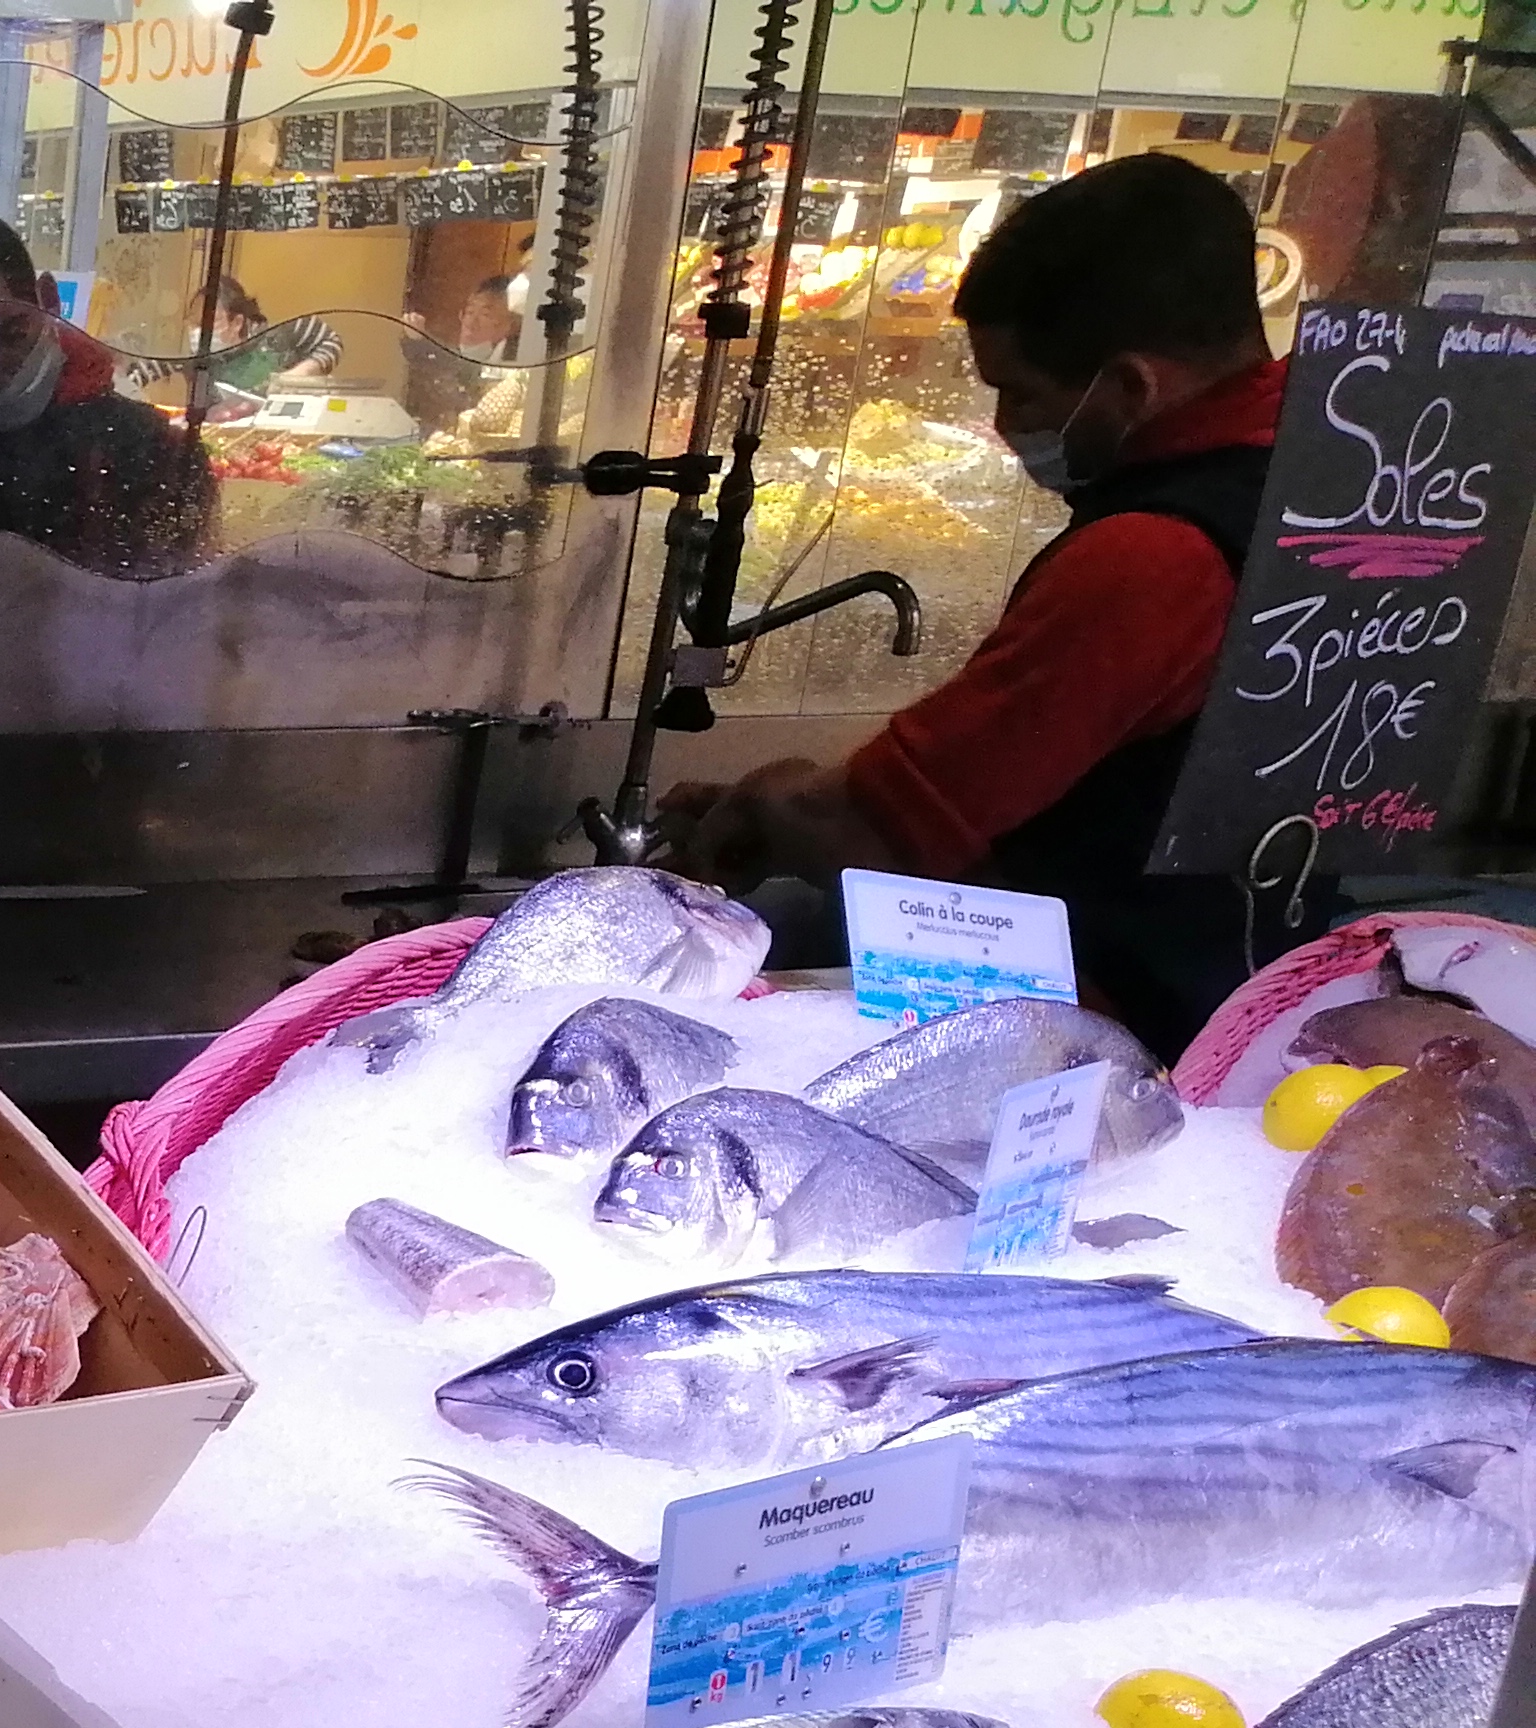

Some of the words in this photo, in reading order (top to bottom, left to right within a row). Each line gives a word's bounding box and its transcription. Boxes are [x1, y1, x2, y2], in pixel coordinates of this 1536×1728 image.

[1299, 308, 1347, 356] FAO
[1282, 355, 1492, 529] Soles
[1236, 594, 1327, 701] 3
[899, 899, 934, 918] Colin
[938, 904, 948, 921] à
[951, 906, 965, 922] la
[969, 912, 1014, 931] coupe
[759, 1487, 875, 1530] Maquereau
